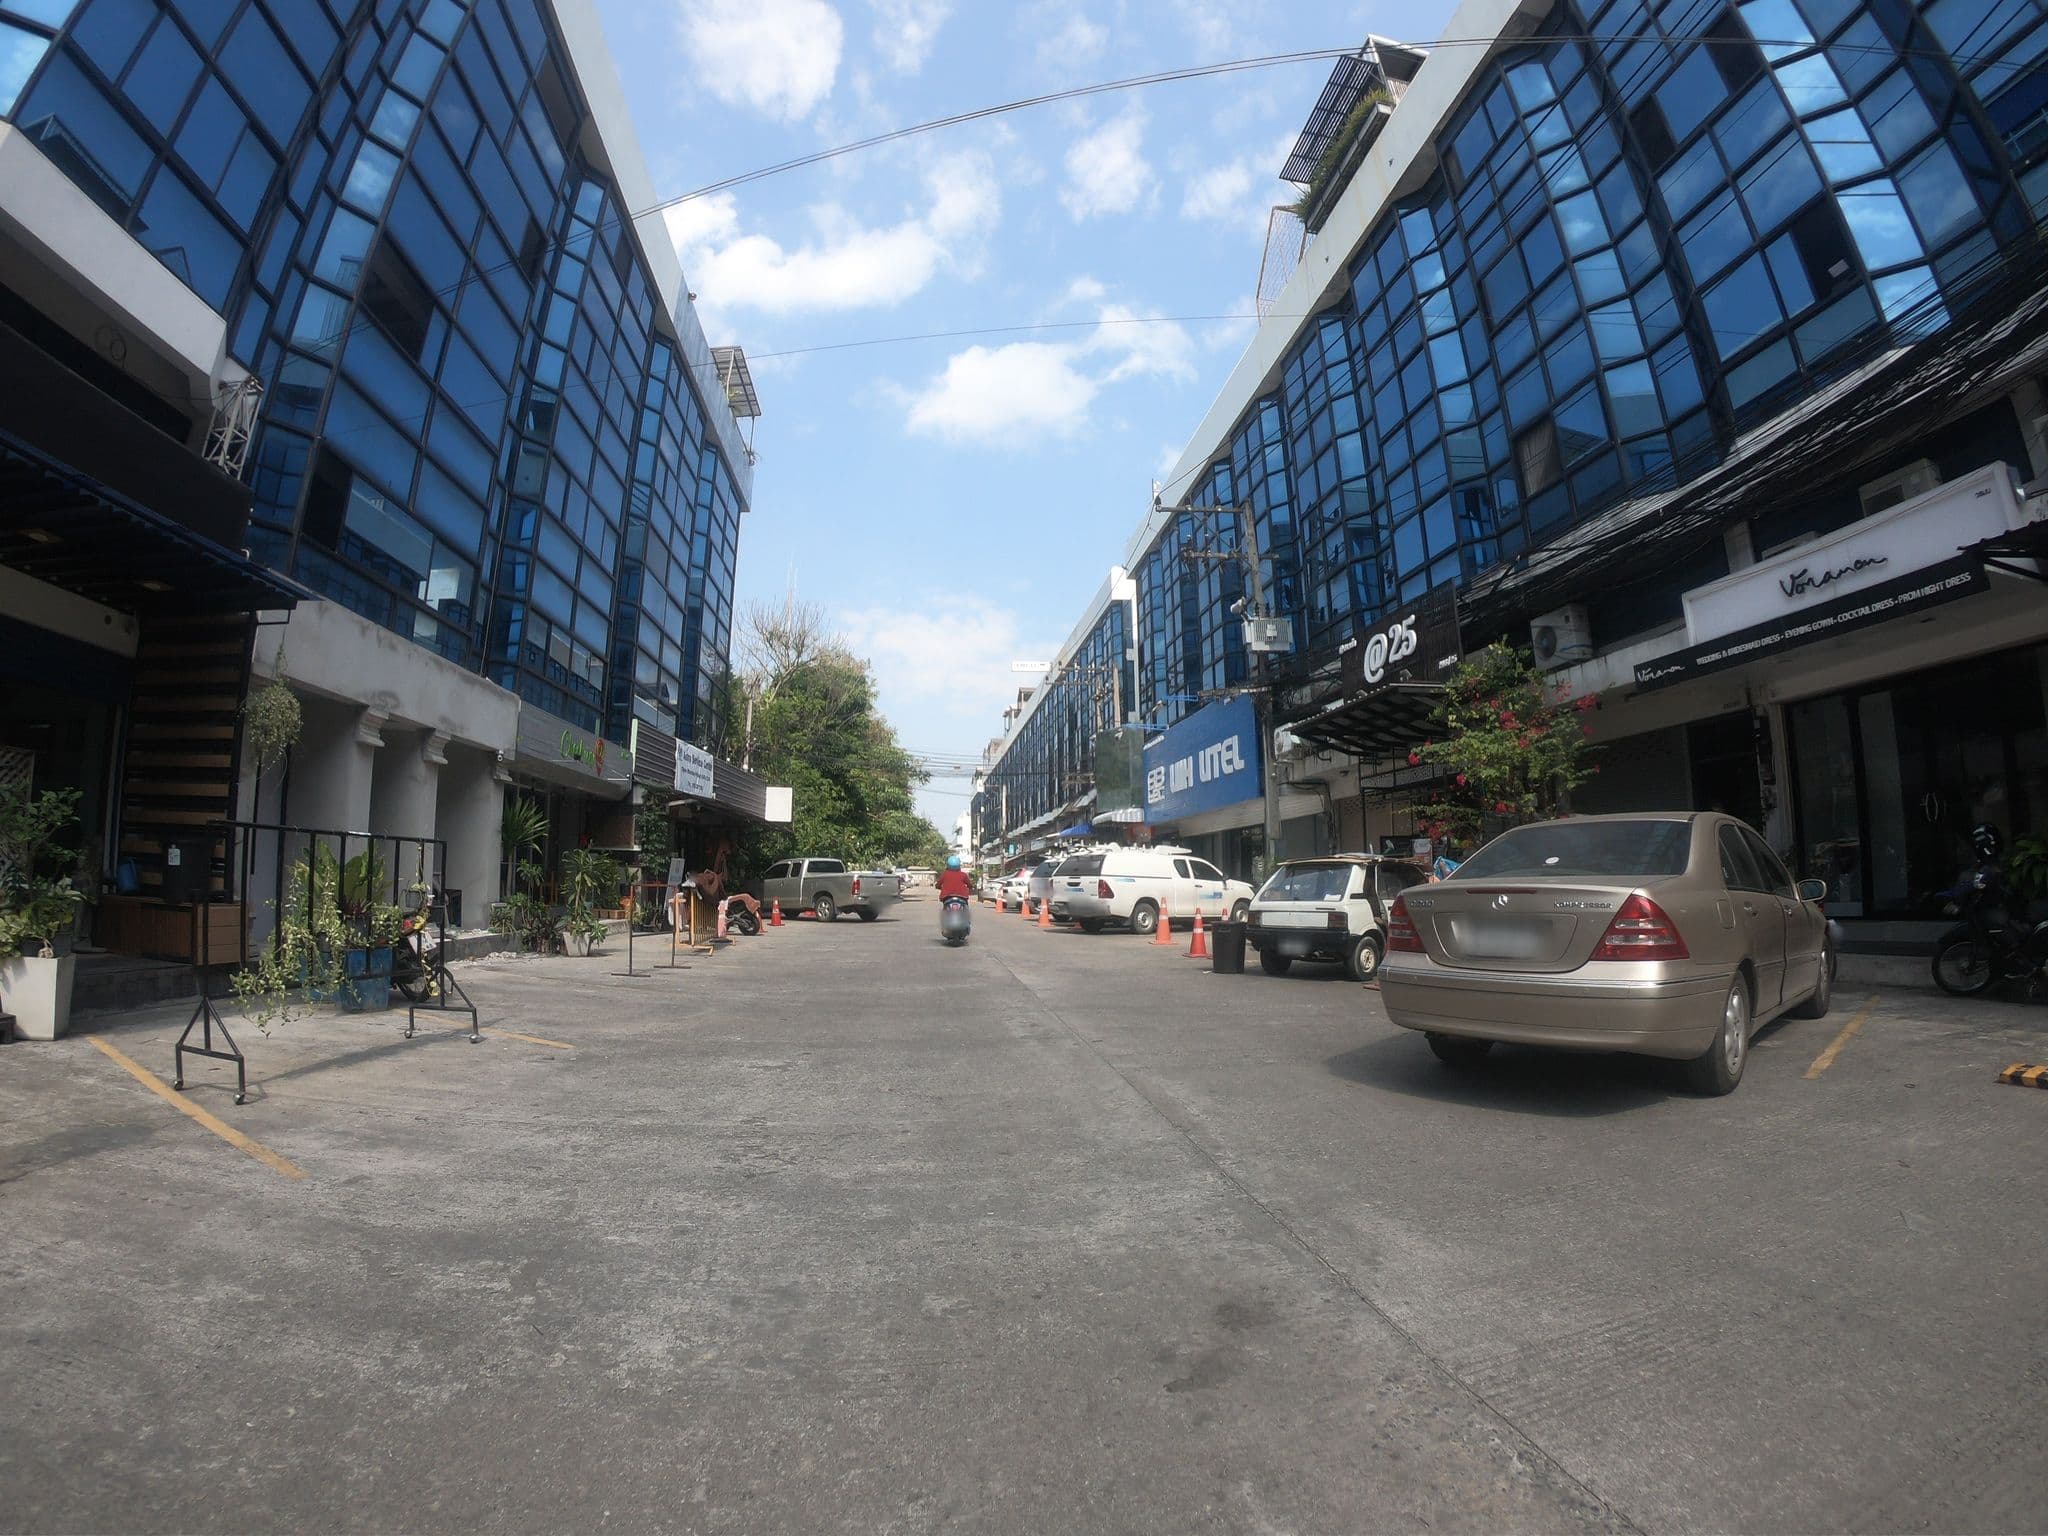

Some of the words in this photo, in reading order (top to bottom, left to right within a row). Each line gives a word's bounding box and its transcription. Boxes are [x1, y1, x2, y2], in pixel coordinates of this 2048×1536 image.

[1761, 633, 1780, 647] DRESS
[1837, 606, 1872, 623] COCKTAIL
[1871, 598, 1895, 613] DRESS
[1897, 589, 1921, 605] PROM
[1920, 581, 1944, 597] NIGHT
[1945, 572, 1972, 589] DRESS
[1363, 614, 1418, 684] @25
[1198, 734, 1245, 783] UTEL
